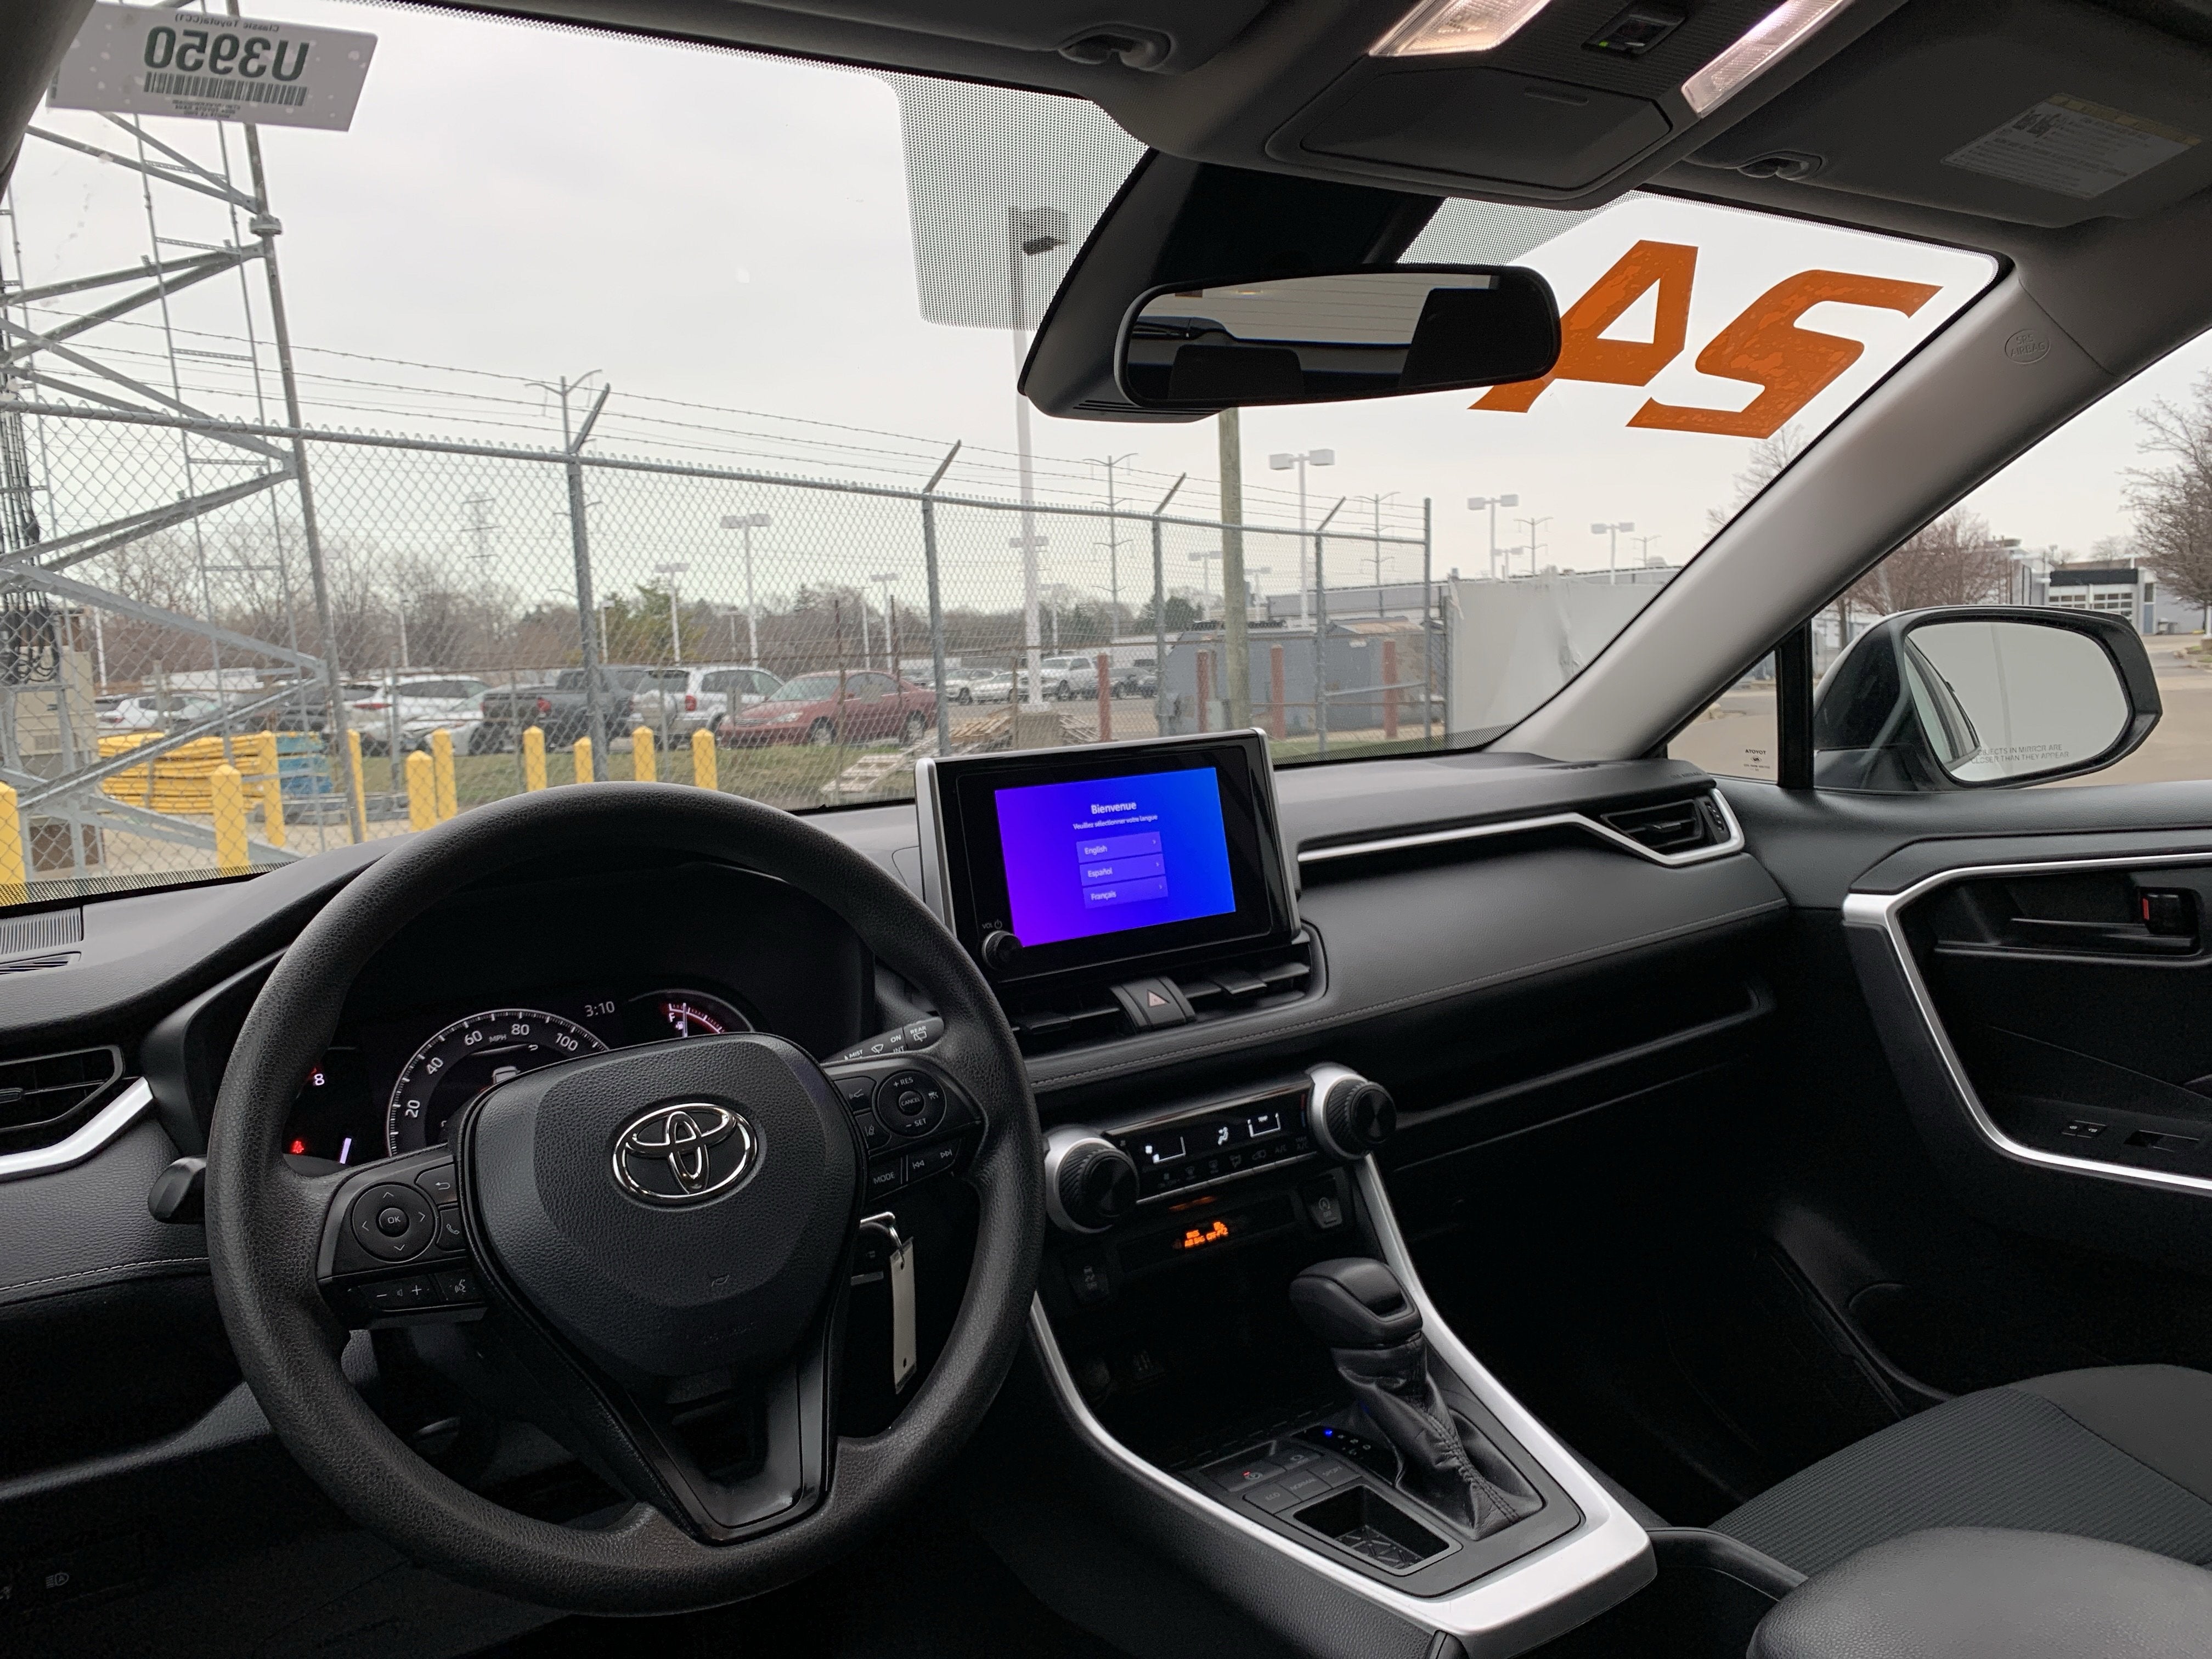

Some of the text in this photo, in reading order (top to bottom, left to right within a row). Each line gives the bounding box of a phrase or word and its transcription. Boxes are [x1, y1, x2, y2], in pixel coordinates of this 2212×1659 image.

[2016, 334, 2034, 345] SRS
[2010, 342, 2046, 358] AIRBAG
[1977, 747, 2008, 755] OBJECTS
[2019, 744, 2047, 753] MIRROR
[1971, 755, 2000, 764] CLOSER
[1091, 802, 1137, 814] Bienvenue
[1073, 821, 1094, 830] Veuillez
[1094, 818, 1125, 827] sélectionner
[1084, 845, 1108, 855] English
[1087, 867, 1113, 878] Español
[1090, 891, 1116, 900] Français
[585, 1001, 616, 1017] 3:10
[669, 1012, 675, 1023] F
[511, 1024, 530, 1036] 80
[910, 1026, 927, 1034] REAR
[464, 1030, 483, 1046] 60
[488, 1034, 507, 1043] MPH
[554, 1032, 579, 1052] 100
[890, 1035, 902, 1043] ON
[849, 1049, 864, 1059] MIST
[425, 1057, 444, 1076] 40
[313, 1073, 325, 1086] 8
[900, 1077, 913, 1086] RES
[901, 1097, 921, 1106] CANCEL
[404, 1099, 421, 1119] 20
[915, 1118, 927, 1126] SET
[873, 1172, 895, 1184] MODE
[387, 1215, 401, 1224] OK
